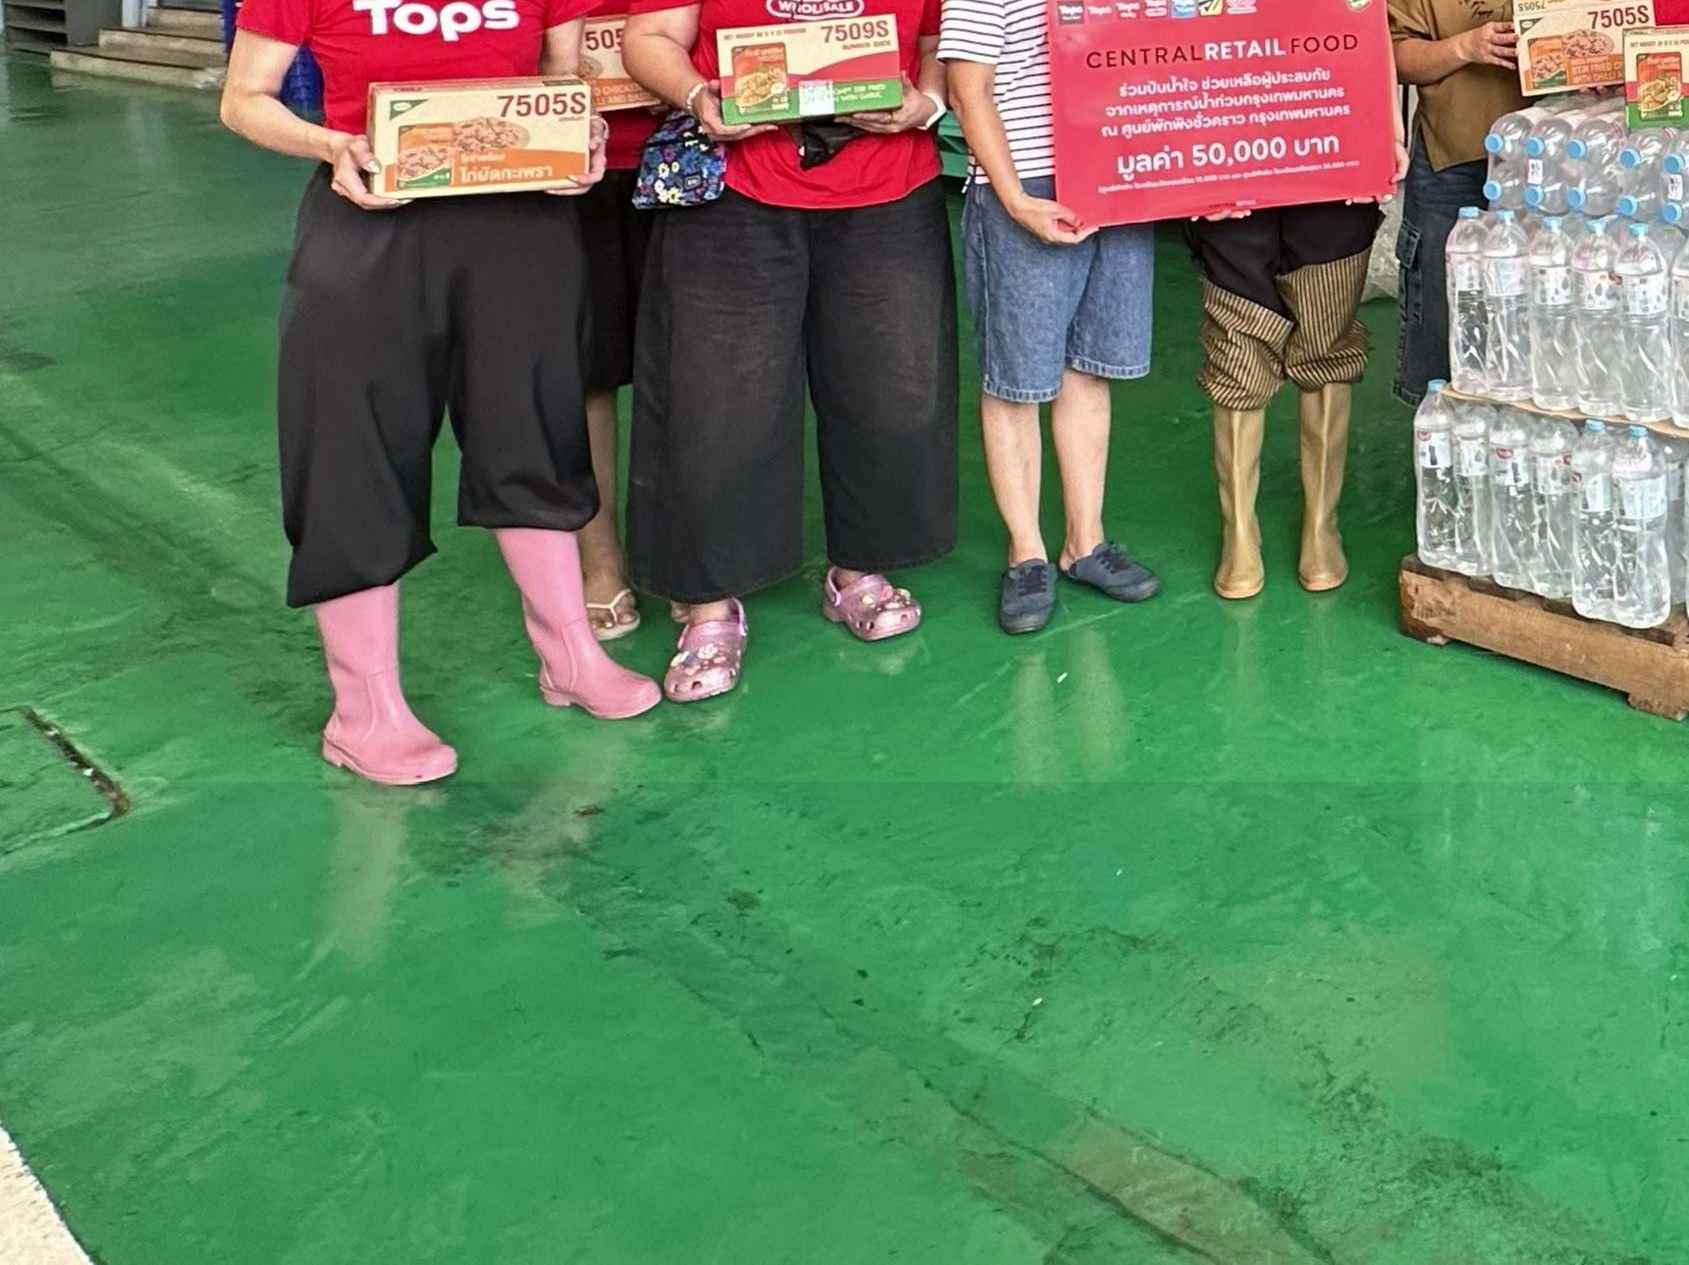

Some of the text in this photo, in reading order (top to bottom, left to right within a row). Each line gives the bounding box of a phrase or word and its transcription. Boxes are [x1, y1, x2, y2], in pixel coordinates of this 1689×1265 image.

[1587, 5, 1650, 29] 7505S
[820, 20, 889, 43] 7509S
[1086, 34, 1358, 69] CENTRAL RETAIL FOOD
[497, 92, 586, 118] 7505S
[1249, 104, 1351, 126] กรุงเทพมหานคร
[1117, 145, 1184, 182] มูลค่า
[1191, 139, 1287, 167] 50,000
[1294, 135, 1340, 155] บาท
